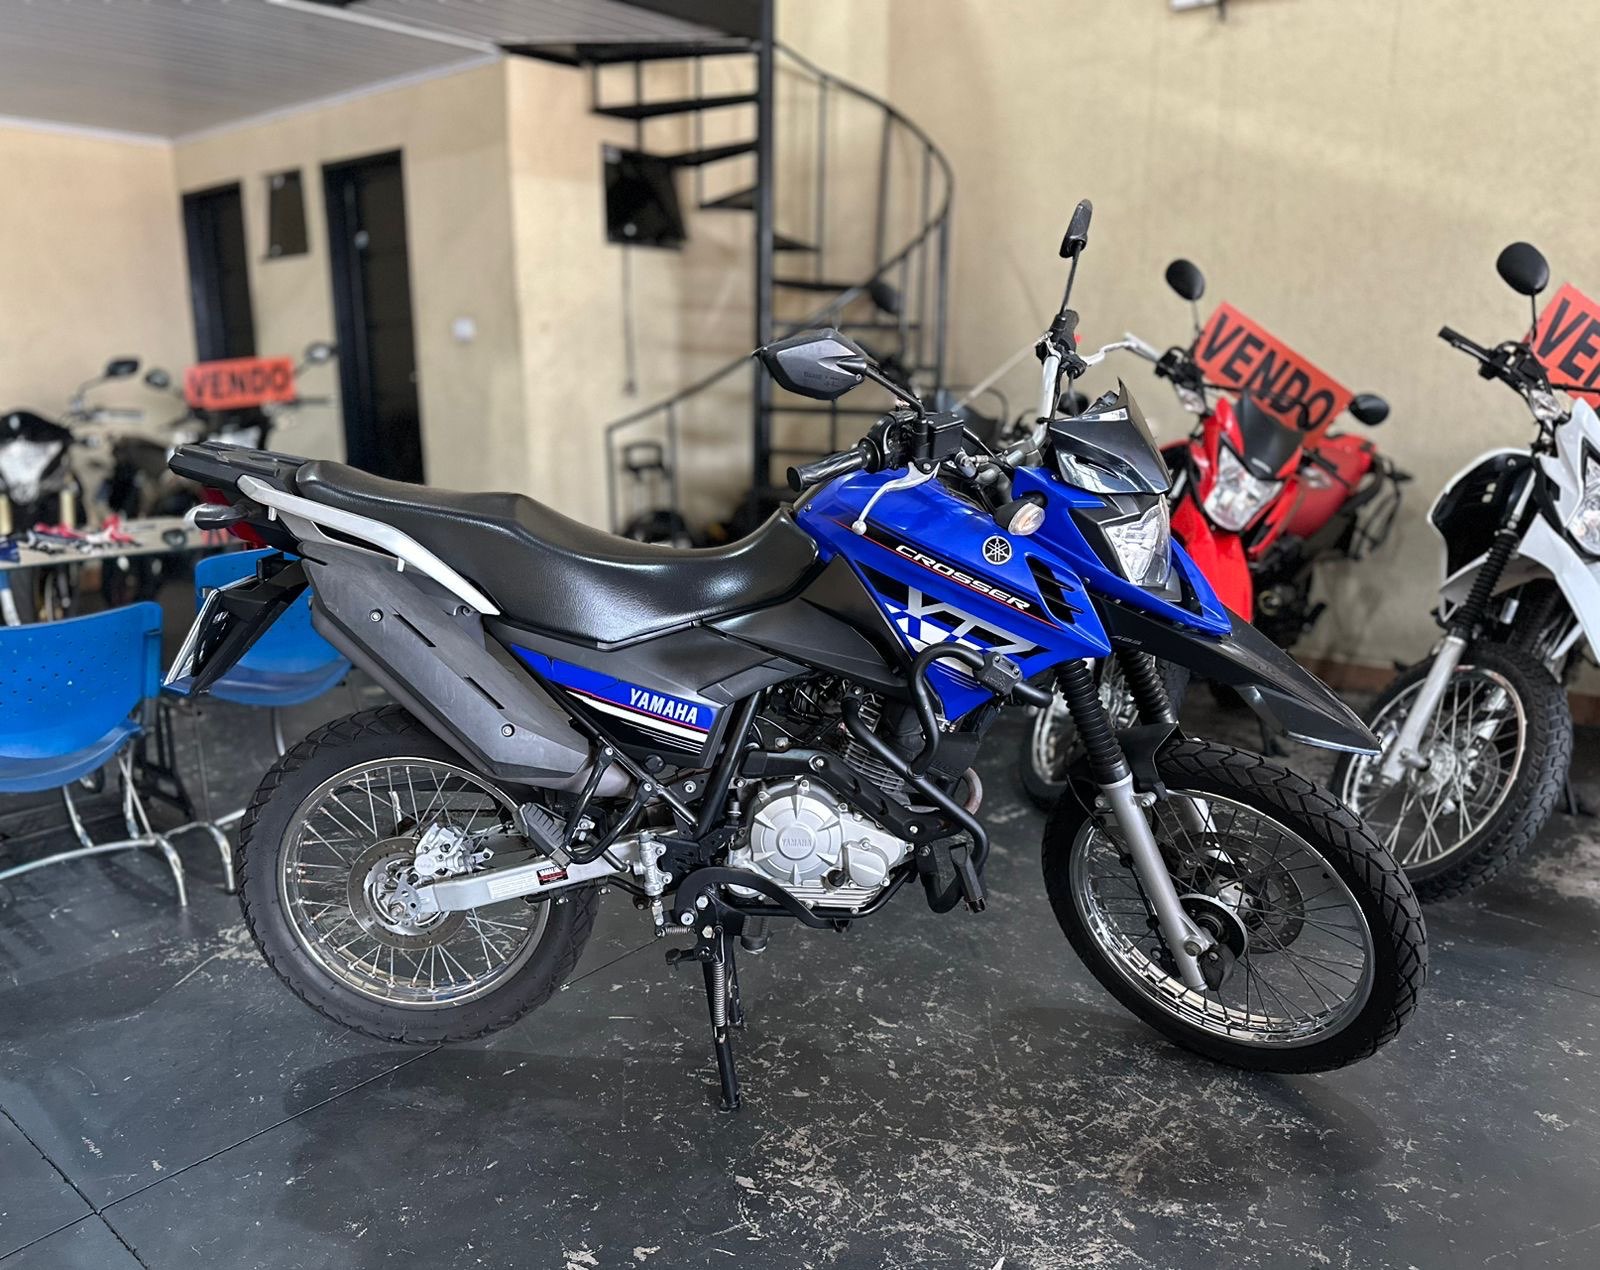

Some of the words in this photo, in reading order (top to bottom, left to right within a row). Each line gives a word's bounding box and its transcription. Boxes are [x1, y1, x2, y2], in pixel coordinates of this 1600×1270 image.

[187, 363, 289, 400] VENDO
[1201, 312, 1335, 432] VENDO
[895, 544, 1031, 610] CROSSER
[629, 687, 698, 725] YAMAHA
[781, 837, 812, 847] YAMAHA
